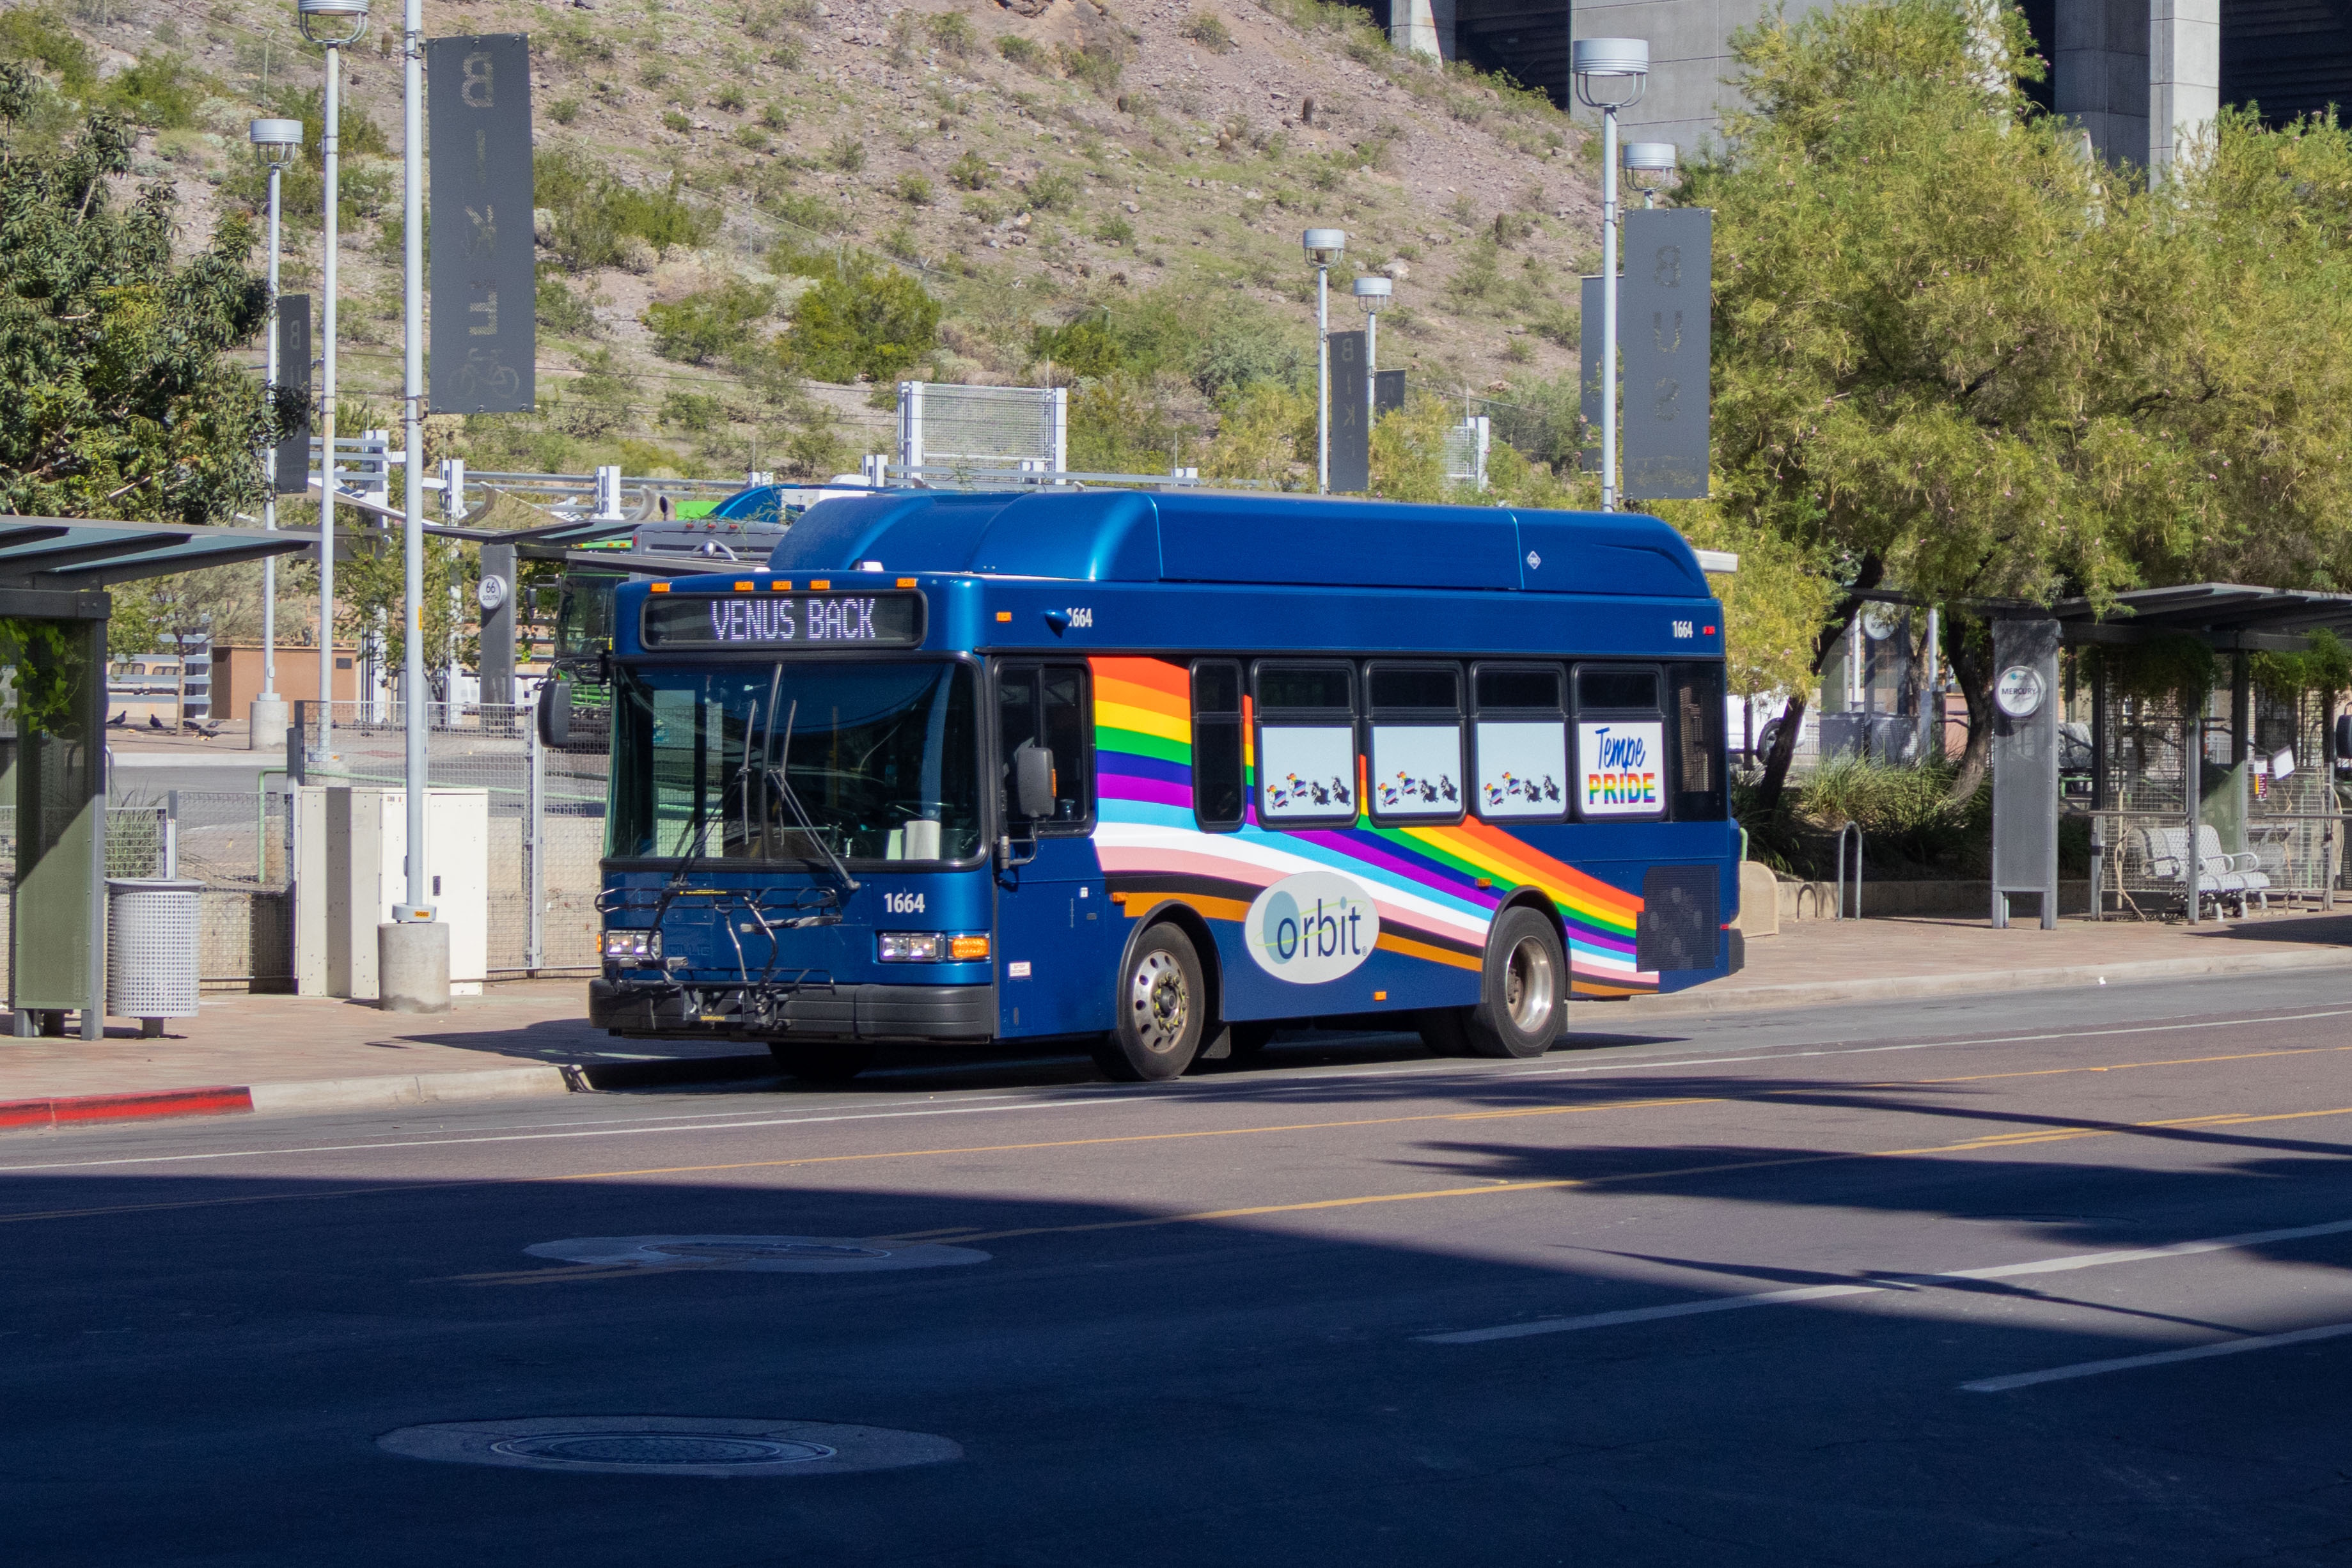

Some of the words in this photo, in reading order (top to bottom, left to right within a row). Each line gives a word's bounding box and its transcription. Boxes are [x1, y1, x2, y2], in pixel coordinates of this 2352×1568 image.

[486, 581, 496, 593] 66
[712, 600, 796, 639] VENUS
[808, 599, 875, 638] BACK
[1066, 608, 1093, 627] 1664
[1672, 620, 1693, 638] 1664
[1595, 726, 1646, 777] Tempe
[1588, 772, 1656, 804] PRIDE
[884, 893, 925, 913] 1664
[1277, 896, 1361, 959] orbit
